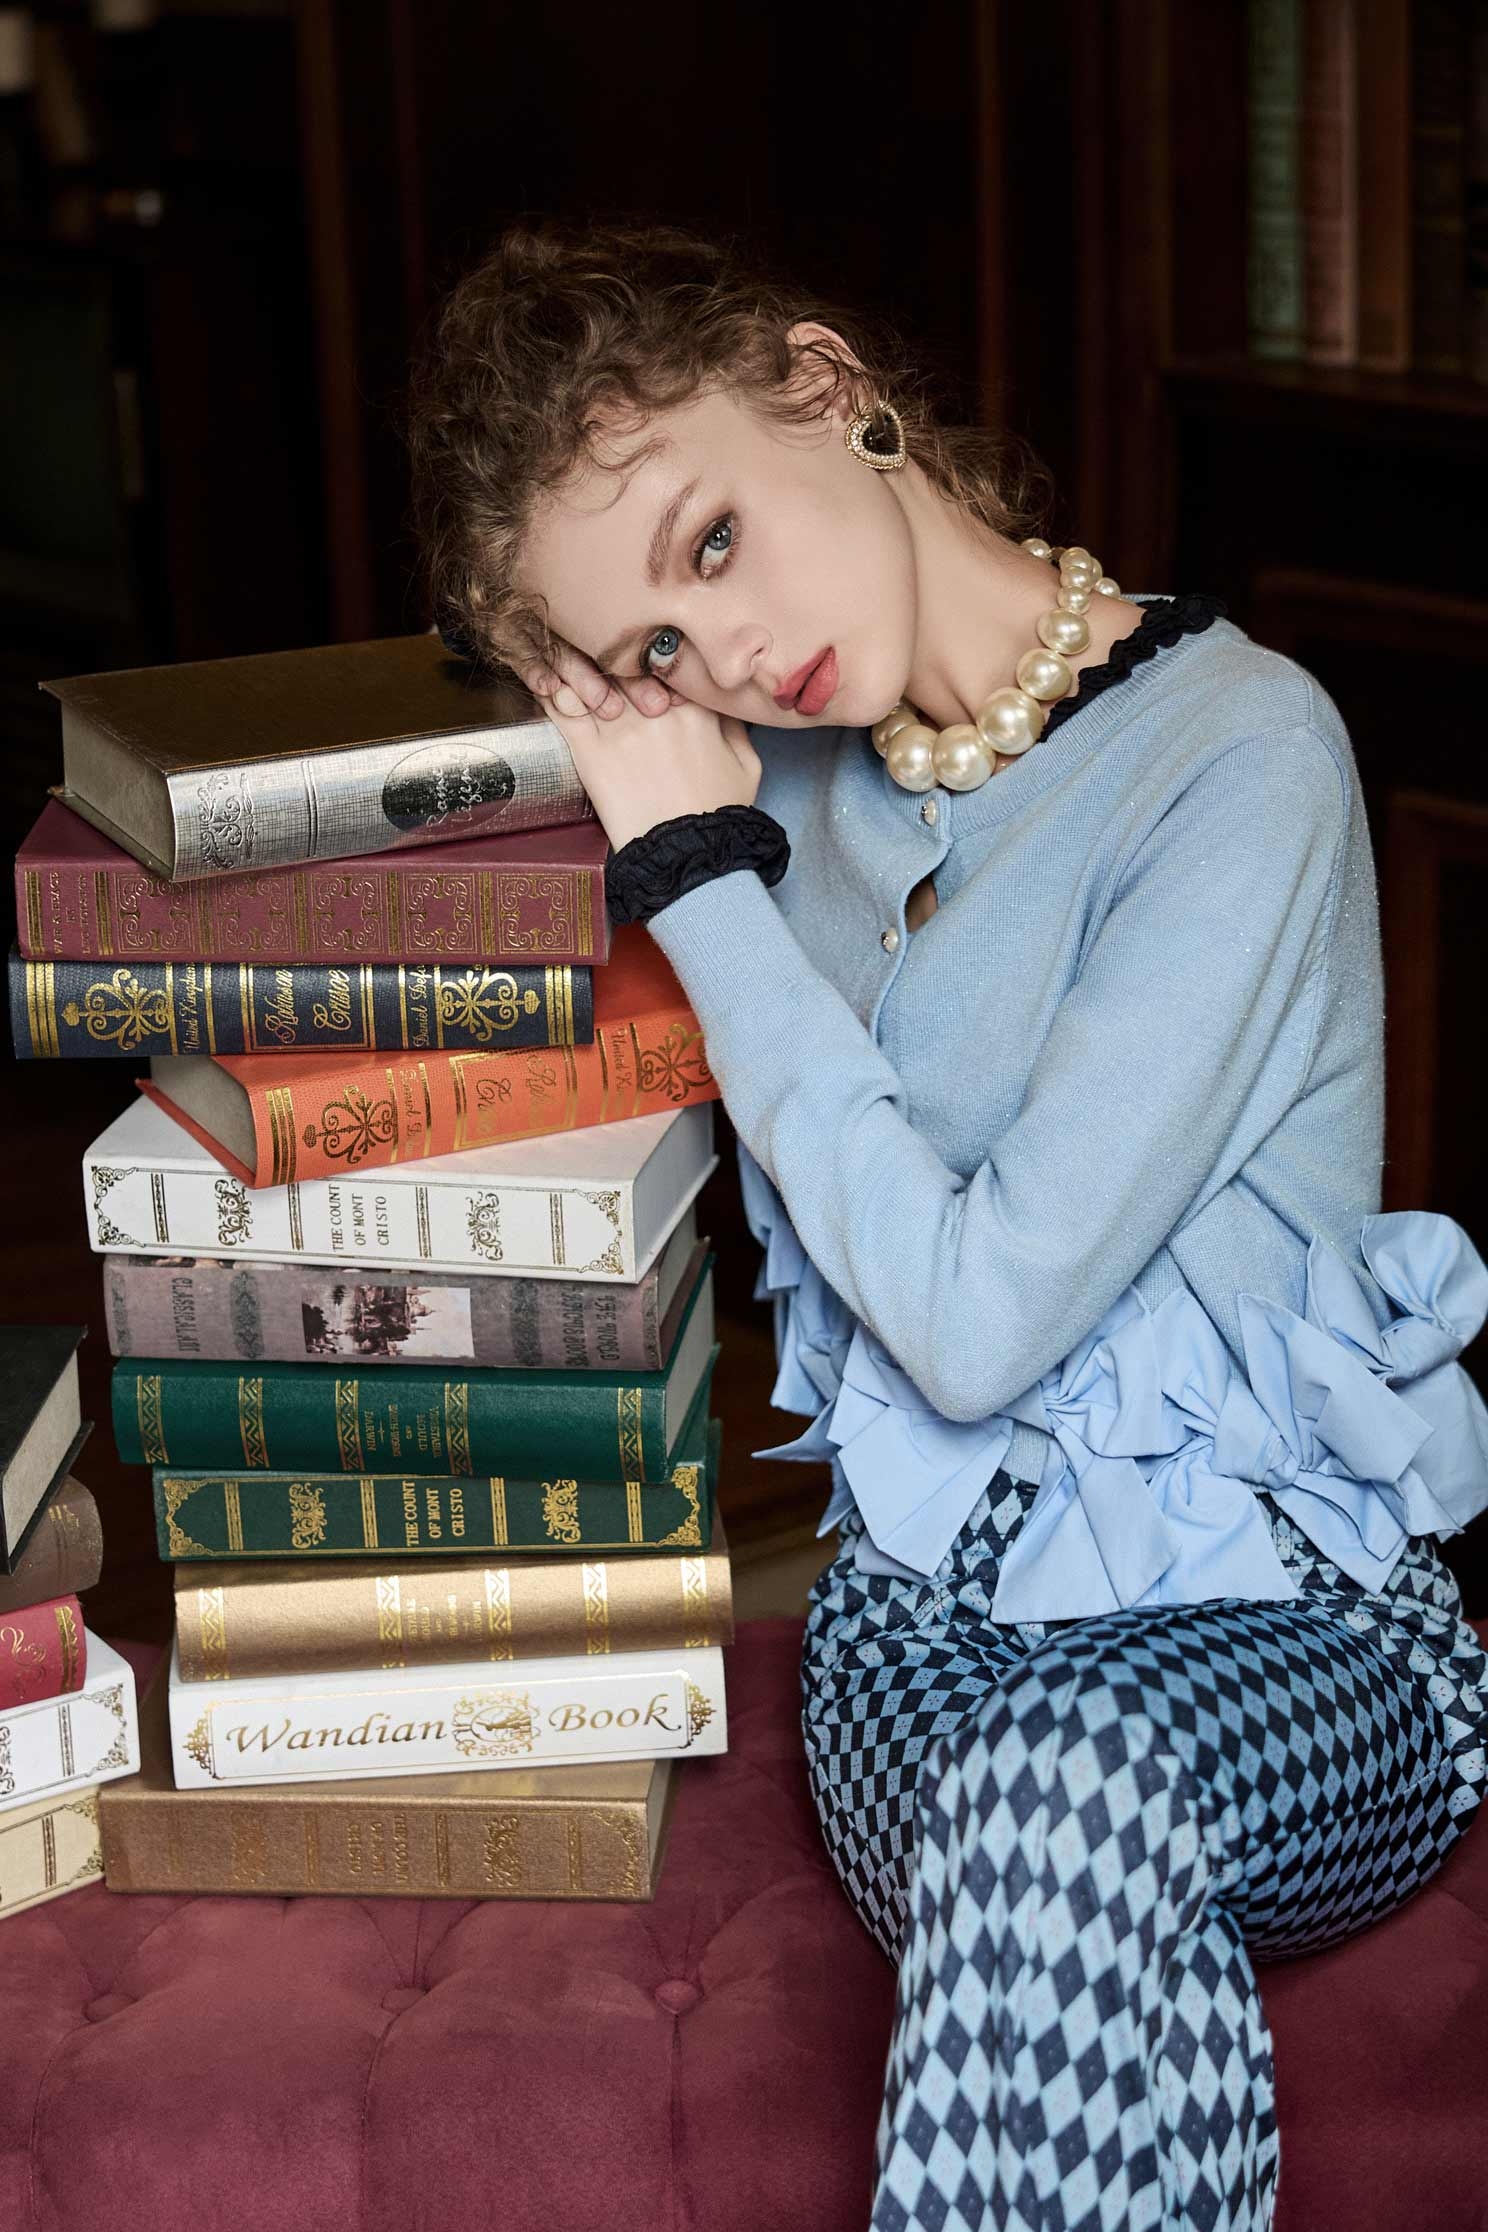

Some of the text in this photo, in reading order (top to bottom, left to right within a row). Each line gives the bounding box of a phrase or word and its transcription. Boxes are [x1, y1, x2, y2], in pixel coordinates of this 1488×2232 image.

[264, 970, 299, 1044] Robinson
[313, 970, 351, 1030] Crusoe
[182, 1018, 200, 1052] United
[411, 1005, 430, 1047] Daniel
[329, 1184, 344, 1252] THE COUNT
[352, 1194, 366, 1246] OF MONT
[375, 1196, 390, 1246] CRISTO
[365, 1411, 376, 1451] DARWIN
[402, 1481, 419, 1546] THE COUNT
[426, 1488, 441, 1538] OF MONT
[450, 1488, 465, 1536] CRISTO
[225, 1693, 682, 1755] Wandian Book
